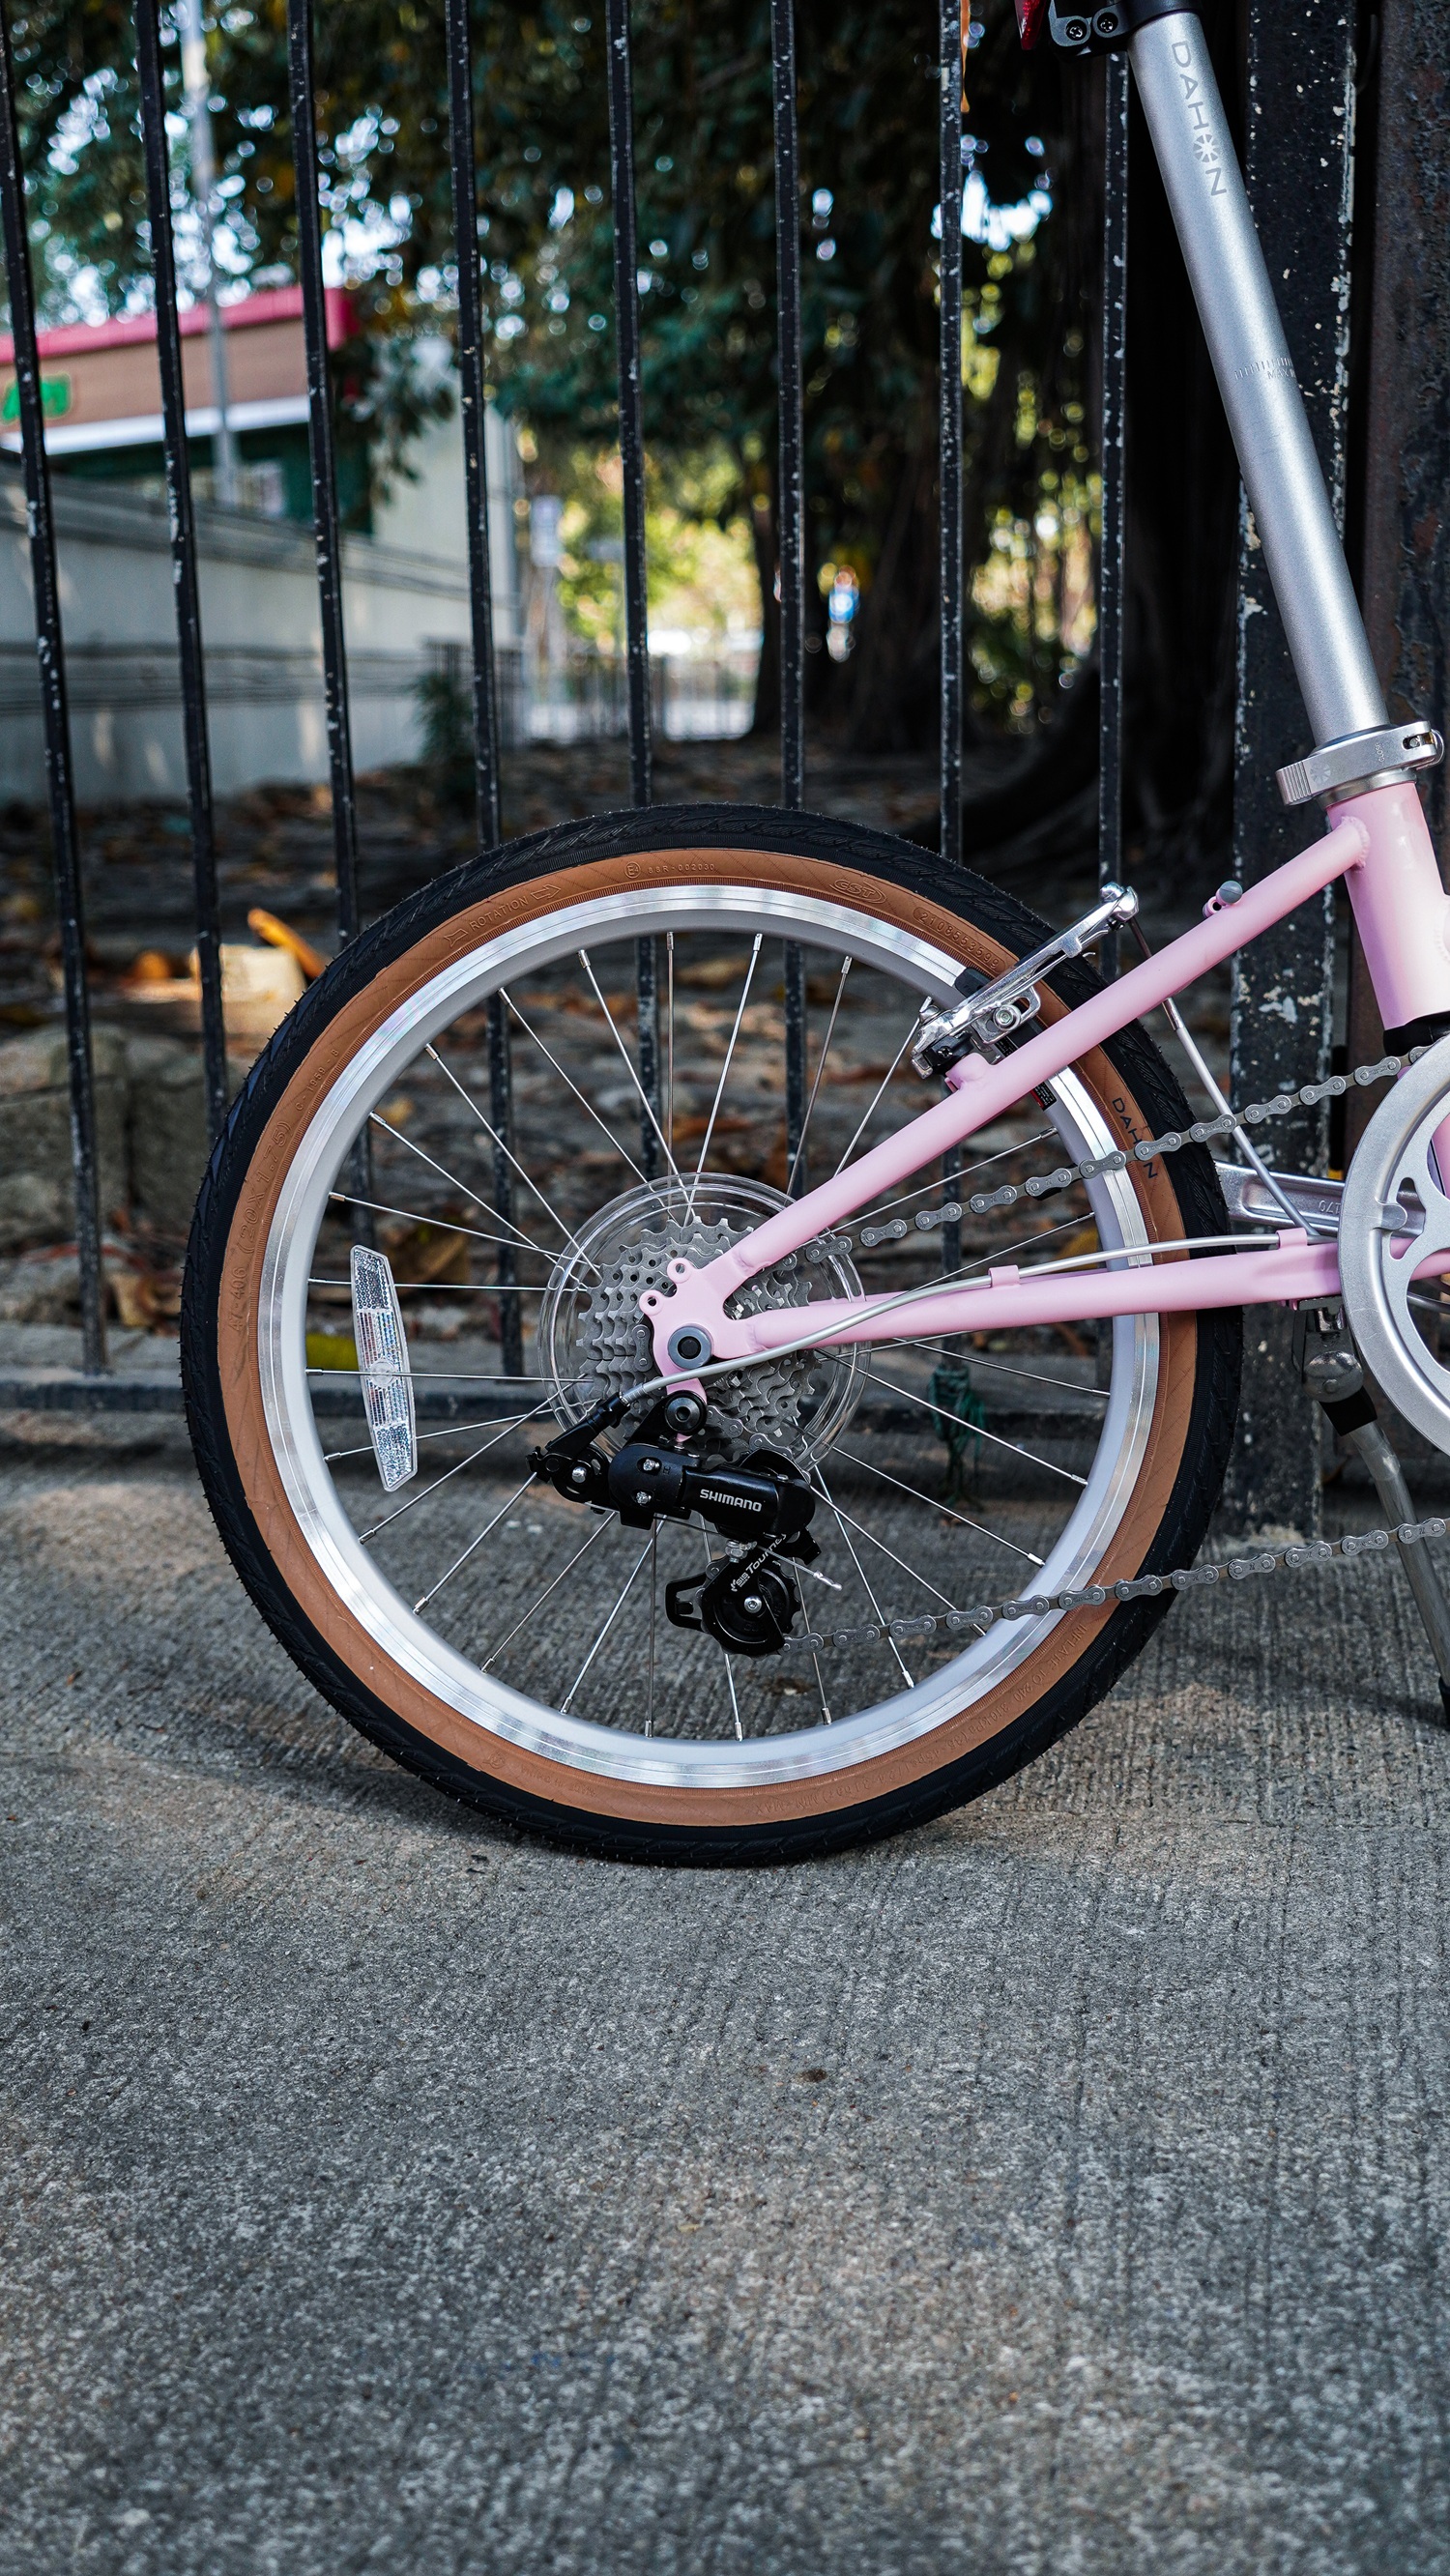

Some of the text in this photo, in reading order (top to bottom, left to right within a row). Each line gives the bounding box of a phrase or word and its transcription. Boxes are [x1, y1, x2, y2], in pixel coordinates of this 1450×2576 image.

[834, 879, 878, 899] CST
[469, 895, 529, 932] ROTATION
[919, 912, 1000, 969] 2108553599
[1112, 1097, 1158, 1179] DAHN
[699, 1489, 763, 1513] SHIMANO
[1045, 1622, 1089, 1670] INFLATE
